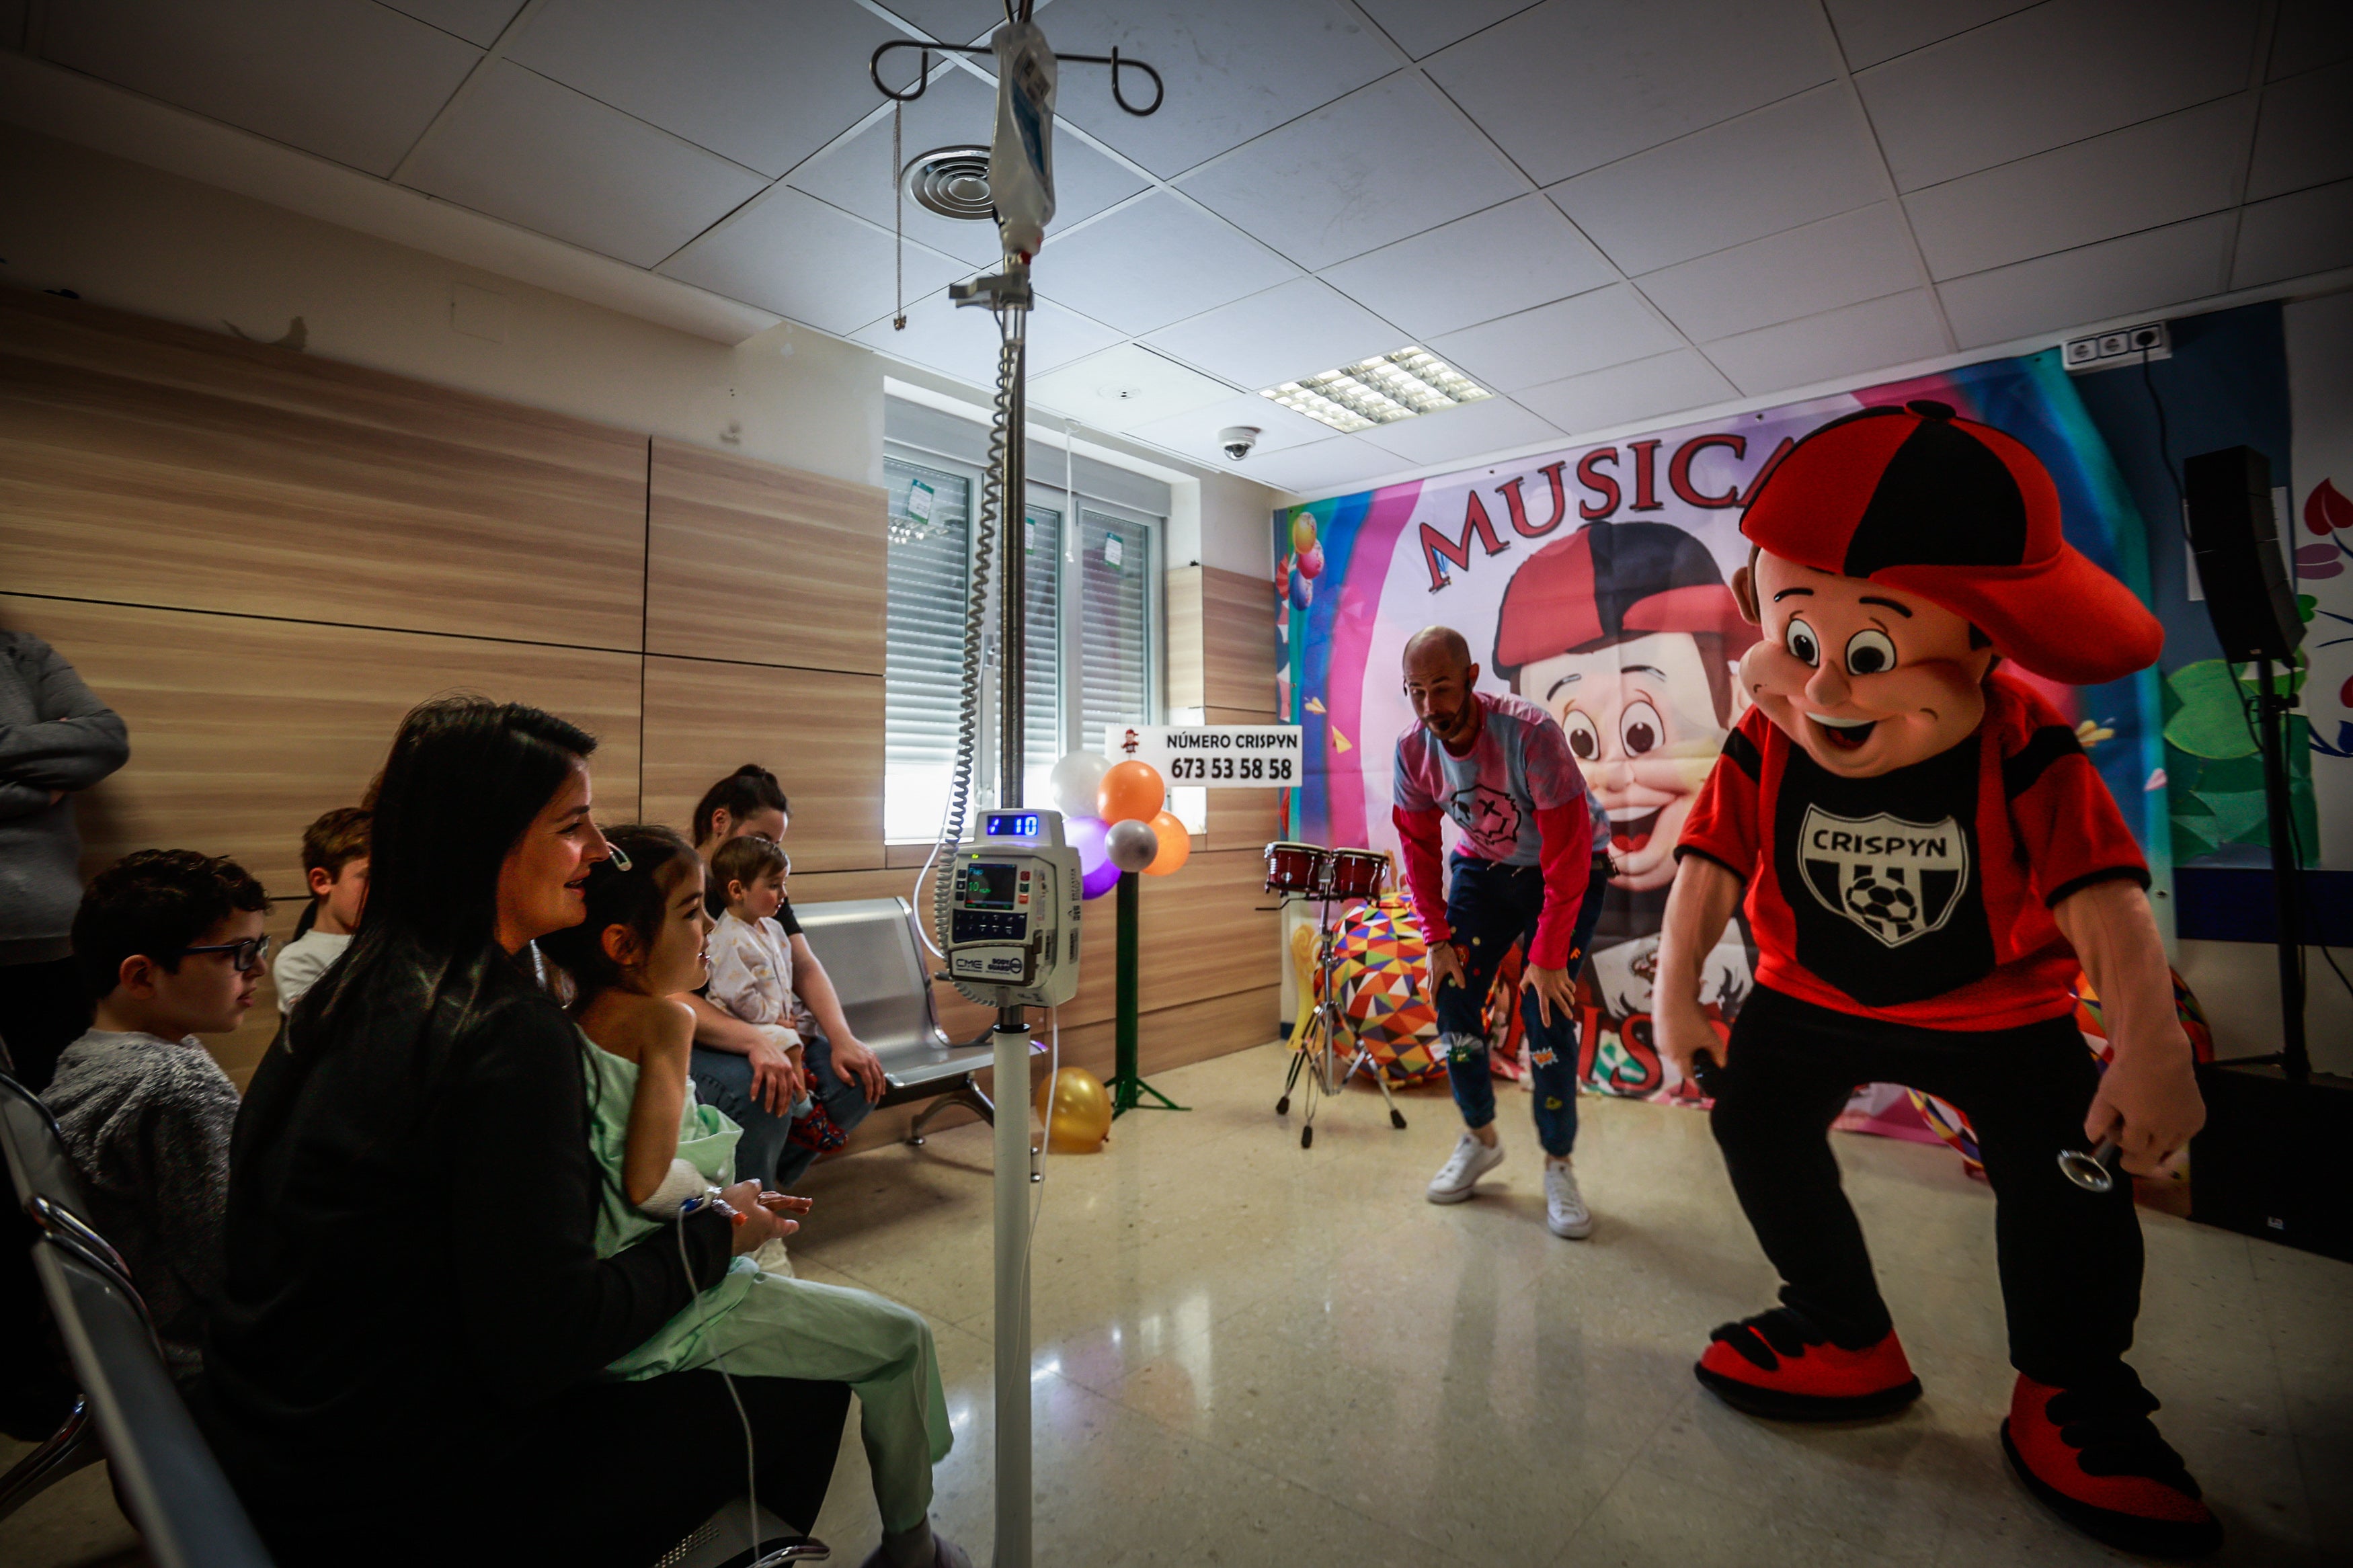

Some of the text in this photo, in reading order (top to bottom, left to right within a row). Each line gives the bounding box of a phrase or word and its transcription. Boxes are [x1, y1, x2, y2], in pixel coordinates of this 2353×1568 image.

[1167, 732, 1298, 749] NÚMERO CRISPYN
[1171, 757, 1292, 780] 673 53 58 58
[1016, 817, 1037, 836] 10
[1813, 829, 1946, 857] CRISPYN
